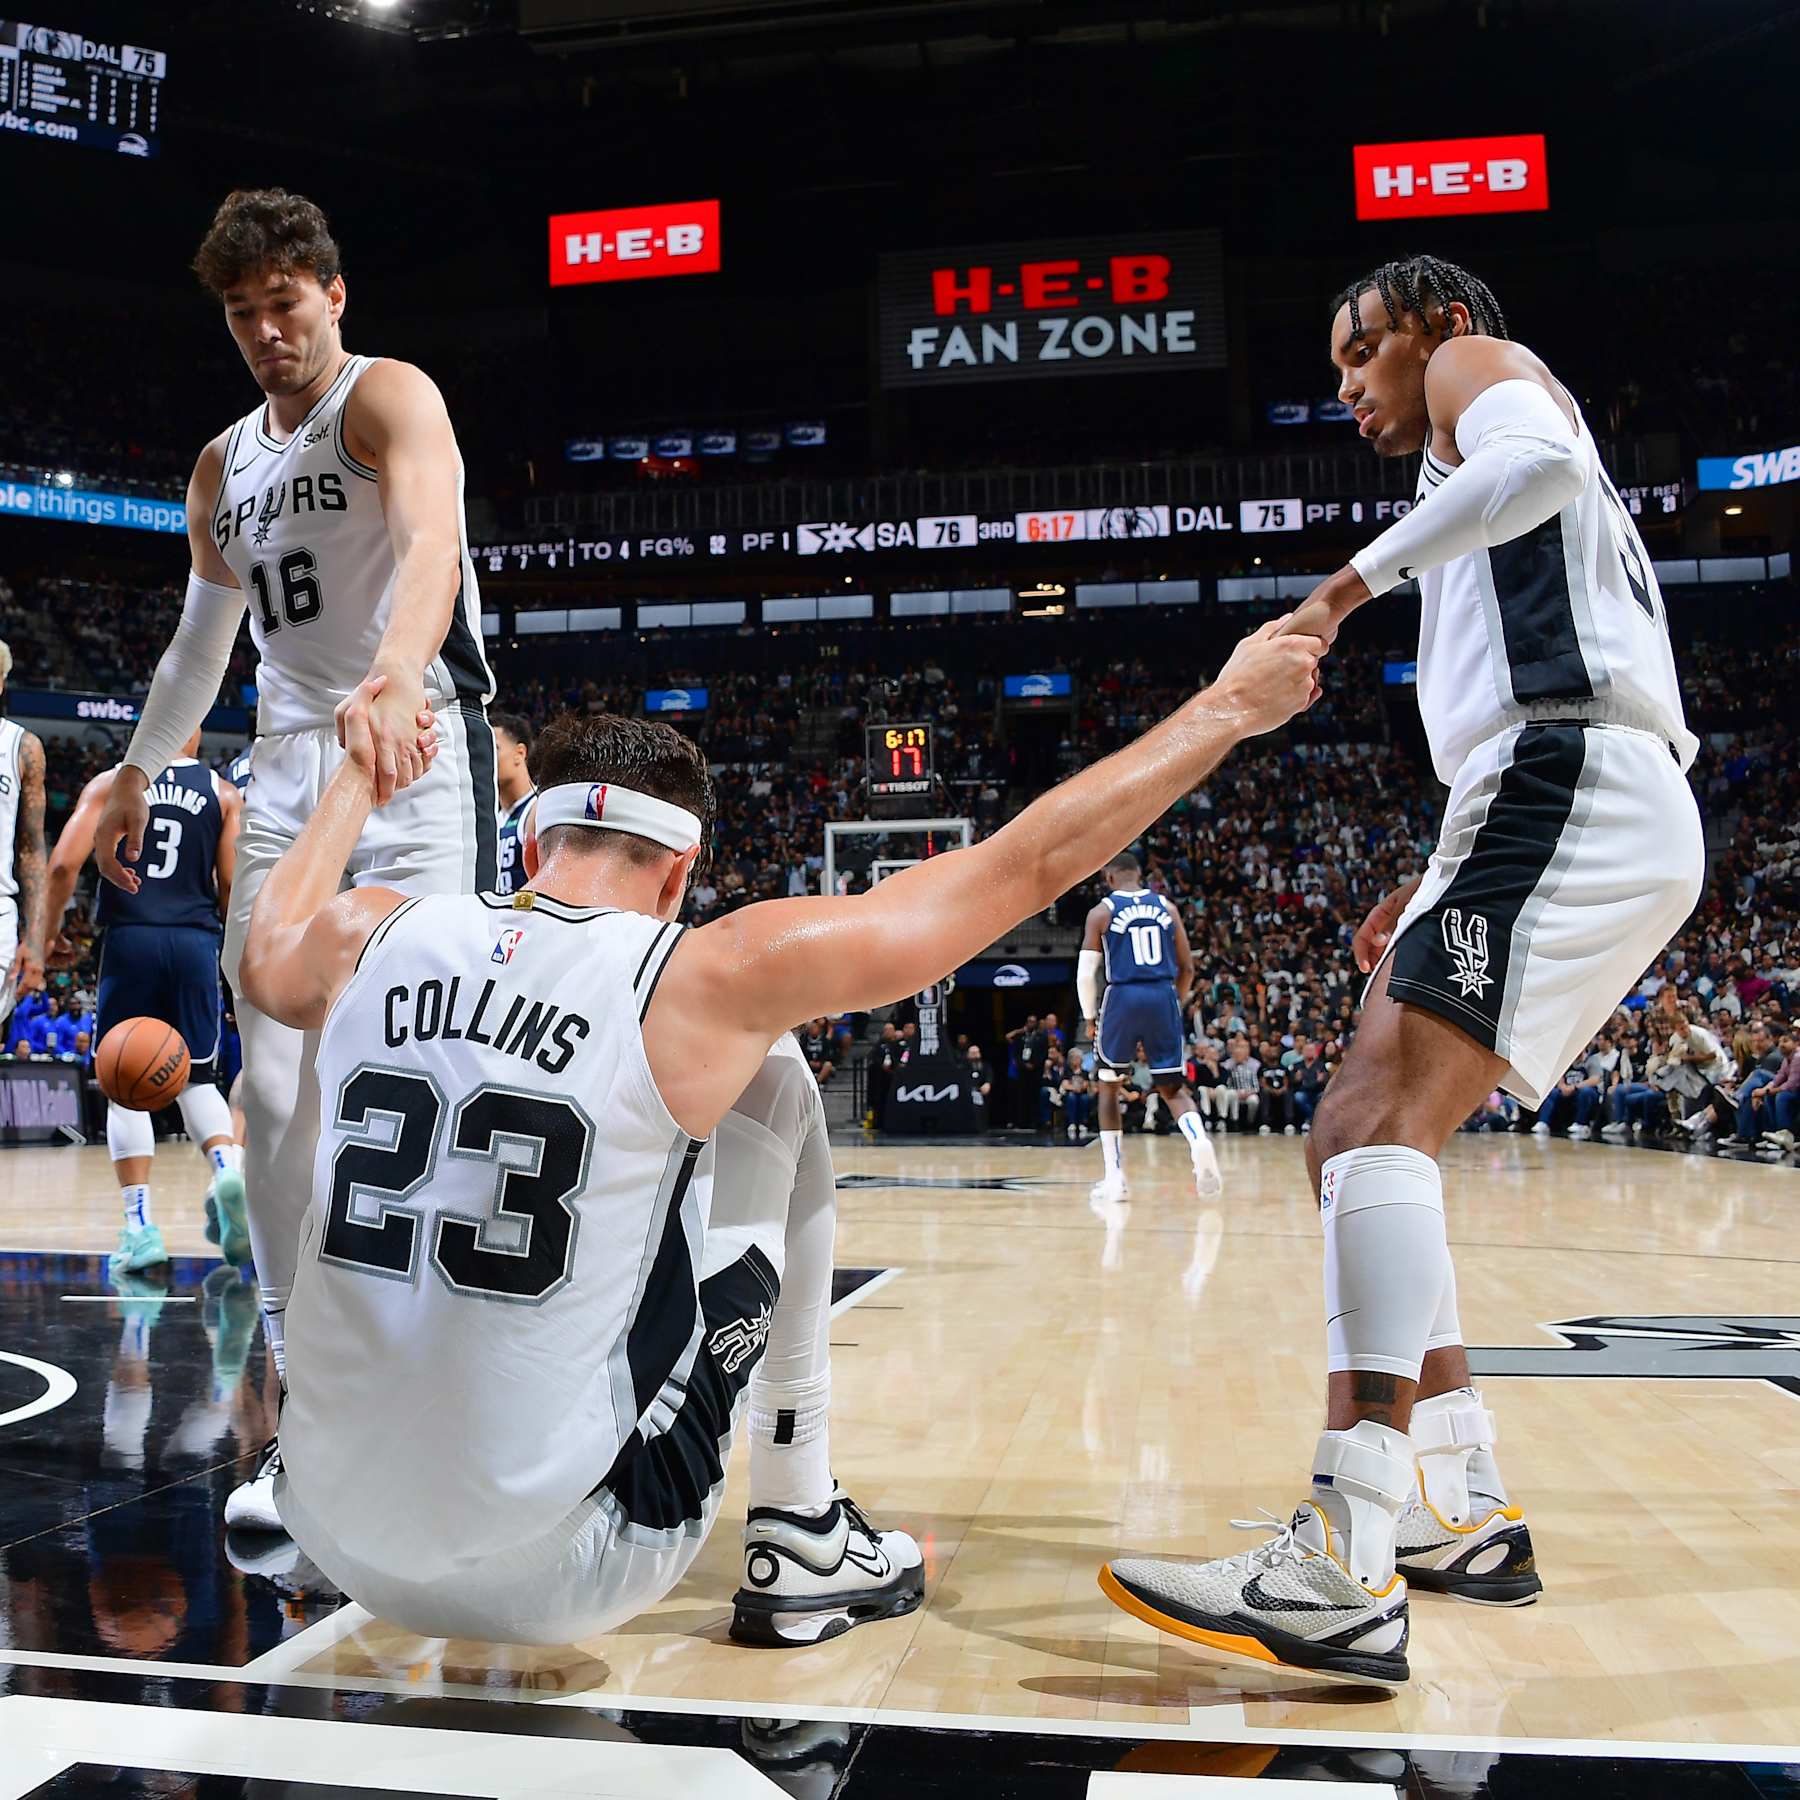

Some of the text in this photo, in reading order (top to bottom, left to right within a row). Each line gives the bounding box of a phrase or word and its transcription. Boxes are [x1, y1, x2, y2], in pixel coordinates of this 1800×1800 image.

[82, 40, 155, 72] DAL 75
[1373, 159, 1528, 198] H-E-B
[565, 224, 704, 265] H-E-B
[932, 255, 1171, 316] H-E-B
[907, 310, 1196, 369] FAN ZONE
[1729, 445, 1800, 490] SWB
[39, 485, 117, 524] things
[215, 473, 348, 552] SPURS
[578, 542, 612, 560] TO
[619, 540, 630, 560] 4
[640, 536, 695, 557] FG%
[743, 532, 775, 552] PF
[877, 522, 915, 548] SA
[935, 522, 960, 544] 76
[979, 520, 1016, 539] 3RD
[1027, 514, 1075, 542] 6:17
[1176, 505, 1233, 532] DAL
[1258, 505, 1285, 528] 75
[1306, 503, 1341, 523] PF
[1376, 500, 1416, 520] FG
[250, 547, 323, 638] 16
[886, 728, 925, 749] 6:17
[892, 747, 921, 776] 17
[143, 782, 208, 815] ILLIAMS
[146, 817, 183, 879] 3
[1127, 925, 1162, 966] 10
[384, 976, 590, 1074] COLLINS
[318, 1061, 597, 1307] 23
